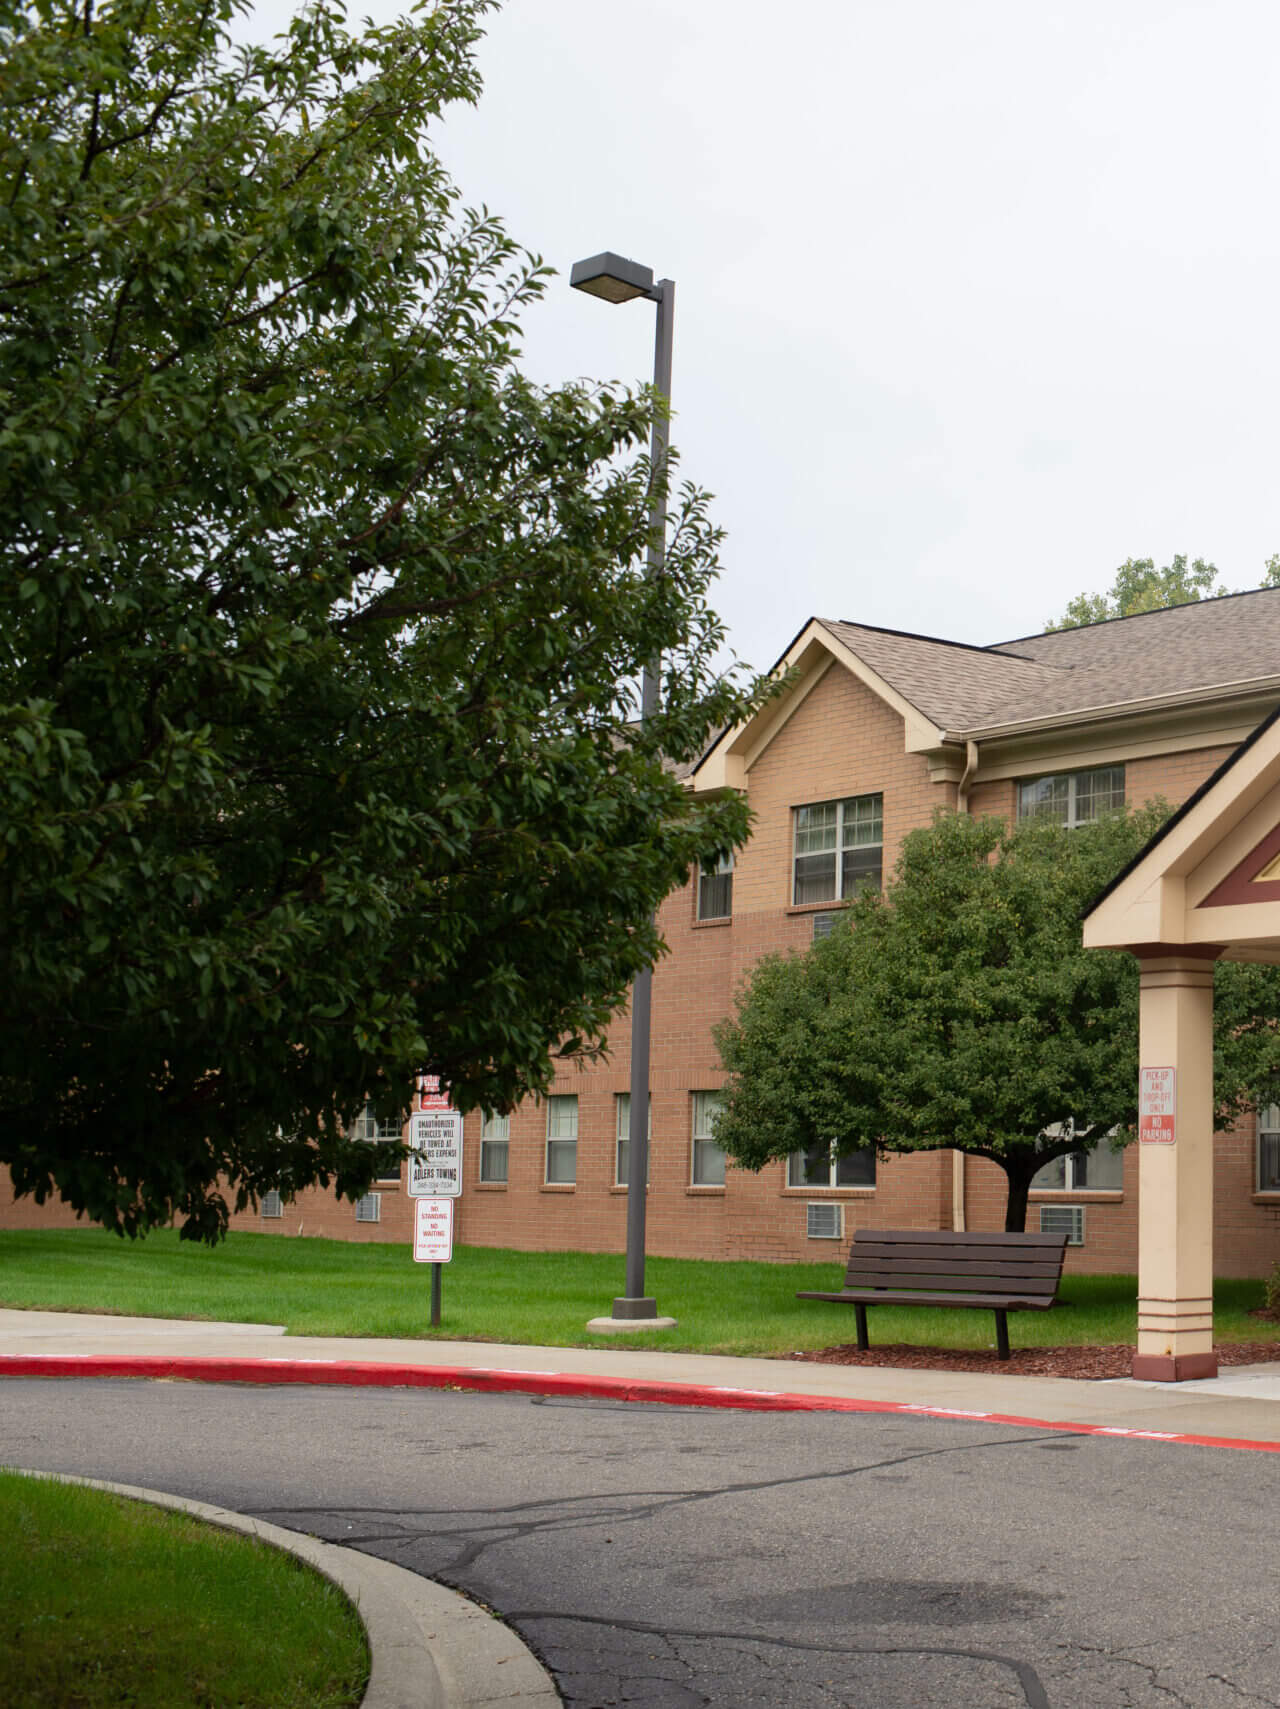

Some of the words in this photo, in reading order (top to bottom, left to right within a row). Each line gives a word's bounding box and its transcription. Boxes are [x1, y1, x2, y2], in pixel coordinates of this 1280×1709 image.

[418, 1120, 455, 1128] UNAUTHORIZED
[1152, 1116, 1162, 1128] NO
[418, 1130, 441, 1138] VEHICLES
[443, 1130, 454, 1138] WILL
[1142, 1128, 1172, 1140] PARKING
[428, 1140, 445, 1148] TOWED
[446, 1139, 452, 1147] AT
[413, 1168, 435, 1181] ADLERS
[436, 1168, 457, 1181] TOWING
